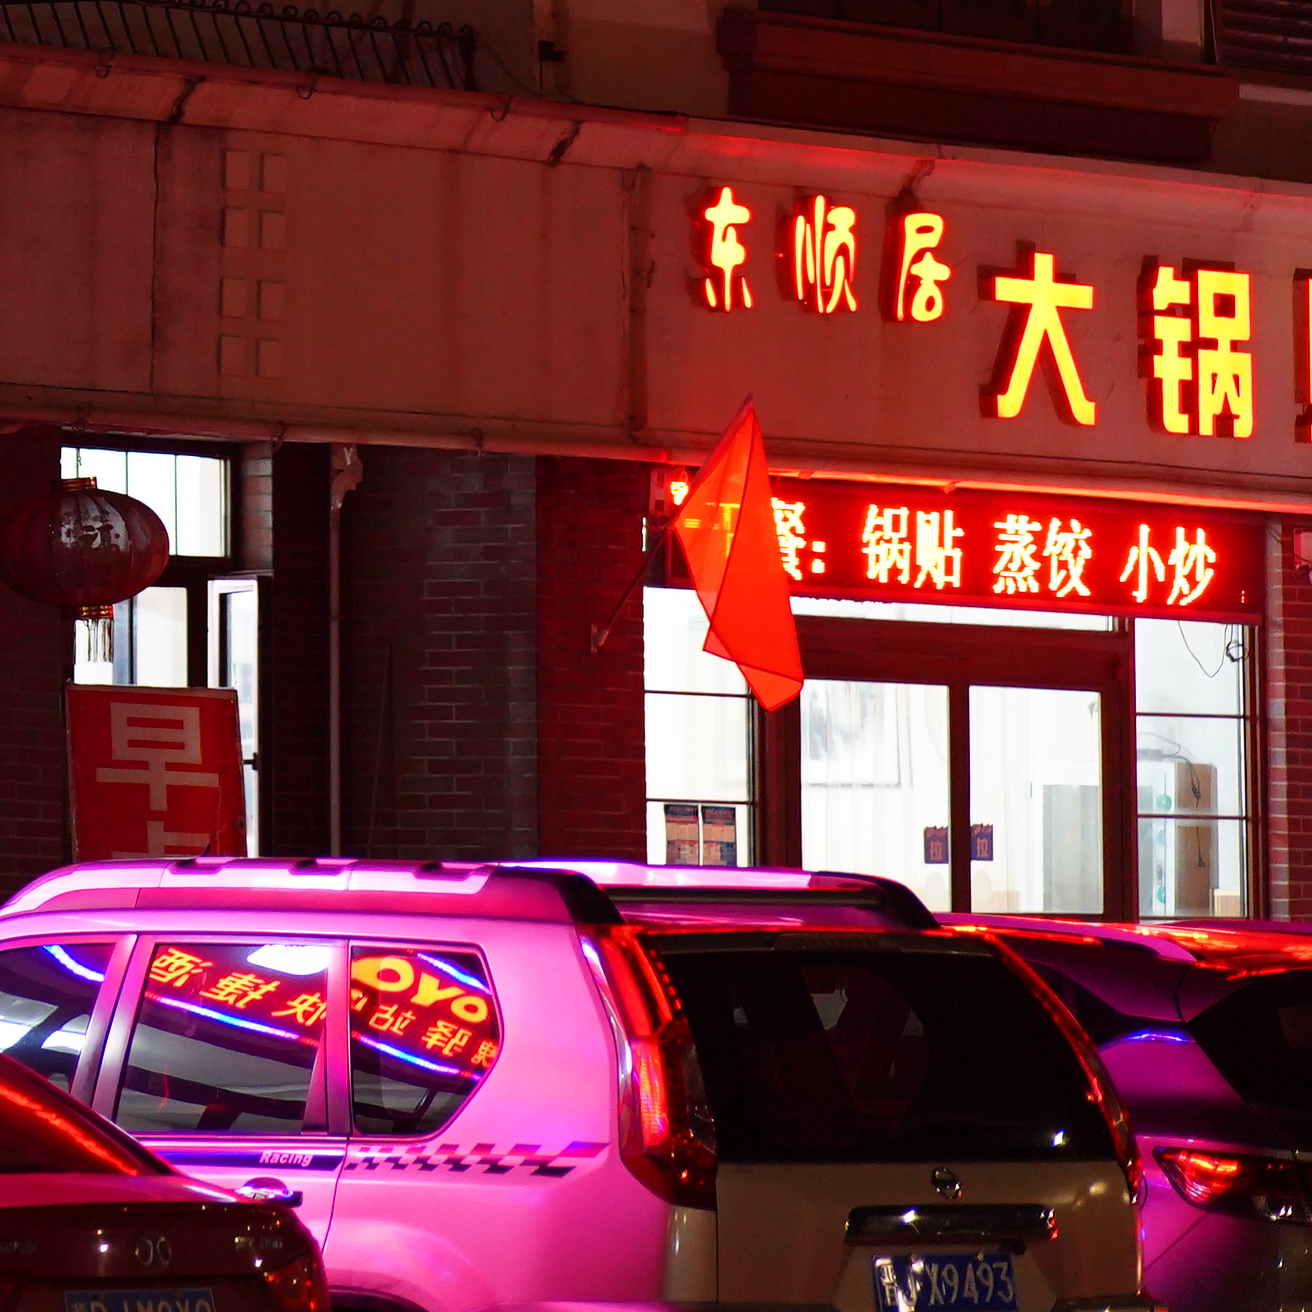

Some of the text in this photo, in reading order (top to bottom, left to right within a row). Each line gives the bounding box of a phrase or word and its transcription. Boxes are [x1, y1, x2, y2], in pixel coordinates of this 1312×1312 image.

[702, 186, 952, 323] 东顺居
[994, 252, 1312, 442] 大锅
[861, 503, 964, 589] 锅贴
[993, 514, 1092, 598] 蒸饺
[1119, 524, 1217, 606] 小炒
[259, 1150, 314, 1167] Racing
